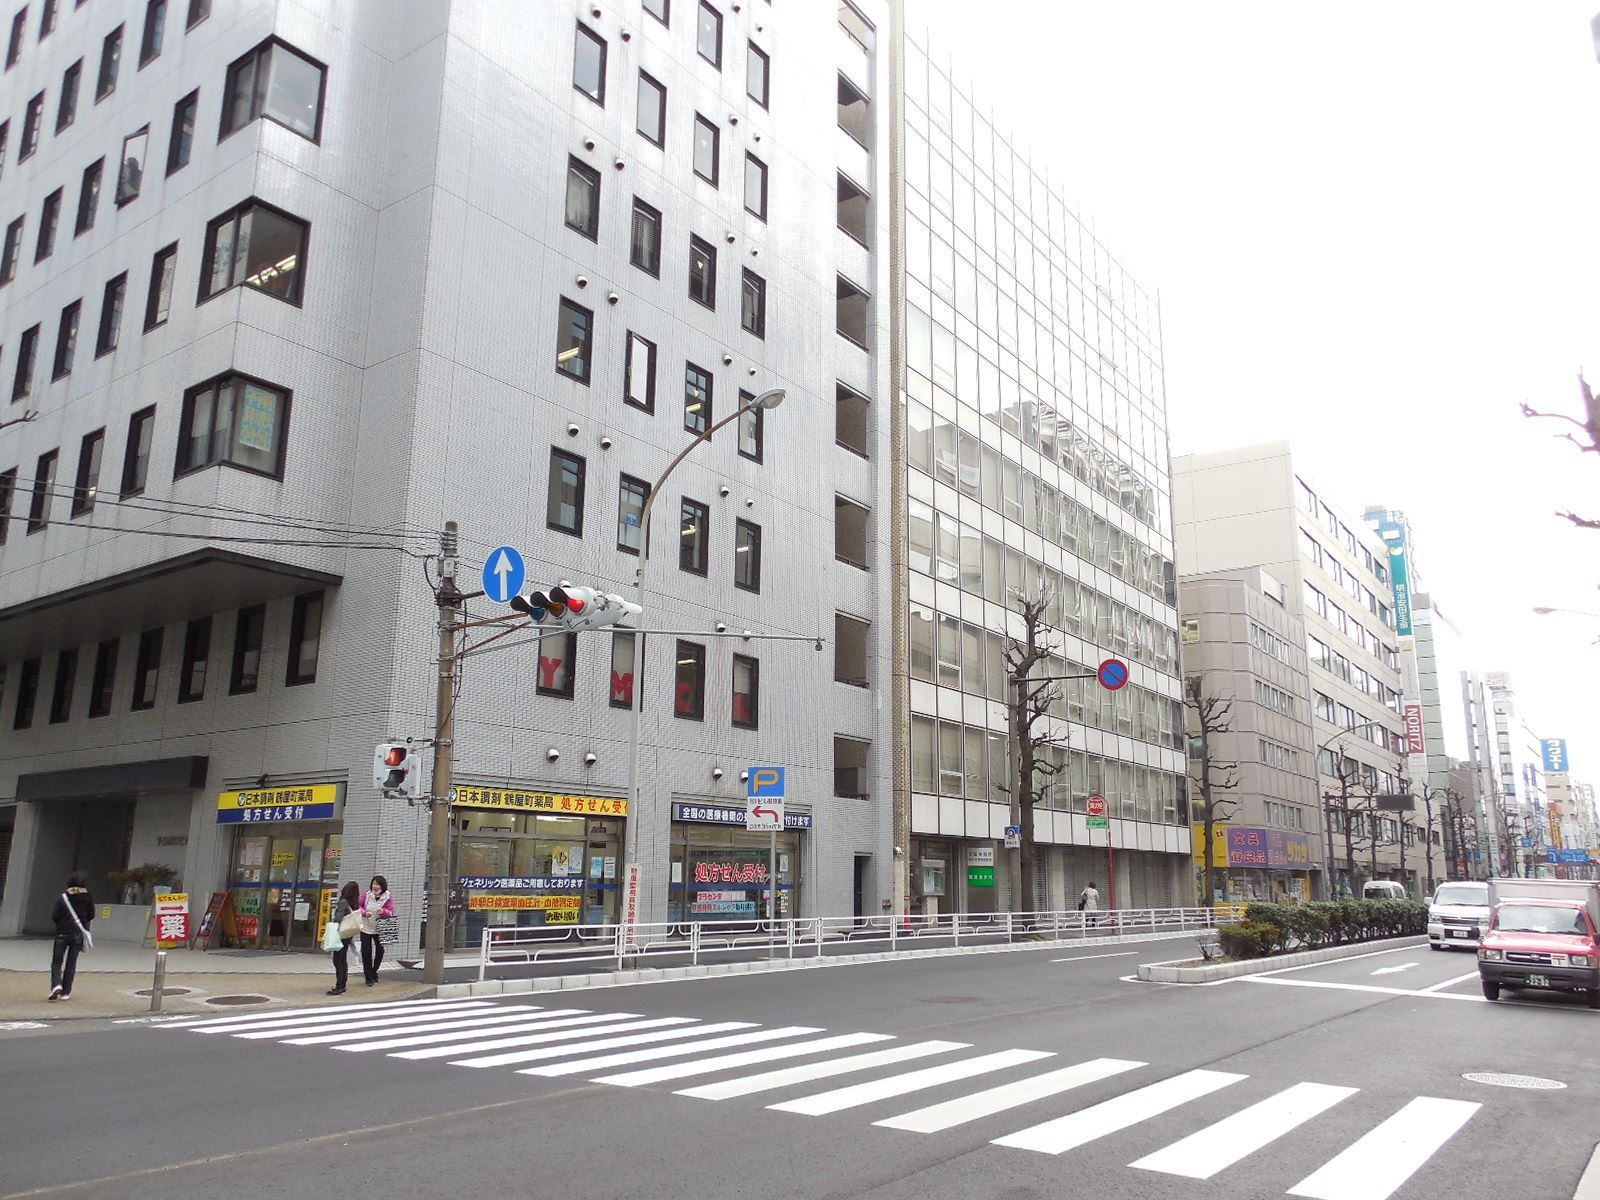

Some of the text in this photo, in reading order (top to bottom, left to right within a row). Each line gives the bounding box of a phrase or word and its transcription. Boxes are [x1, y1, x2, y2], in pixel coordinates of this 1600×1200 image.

[1407, 708, 1422, 751] NORITZ
[753, 769, 779, 794] P
[458, 789, 501, 805] 日本調剤
[242, 806, 305, 821] 処方せん受付
[460, 877, 583, 889] ジェネリック医薬品ご用意しております
[695, 862, 766, 883] 処方せん受付
[160, 914, 185, 939] 薬
